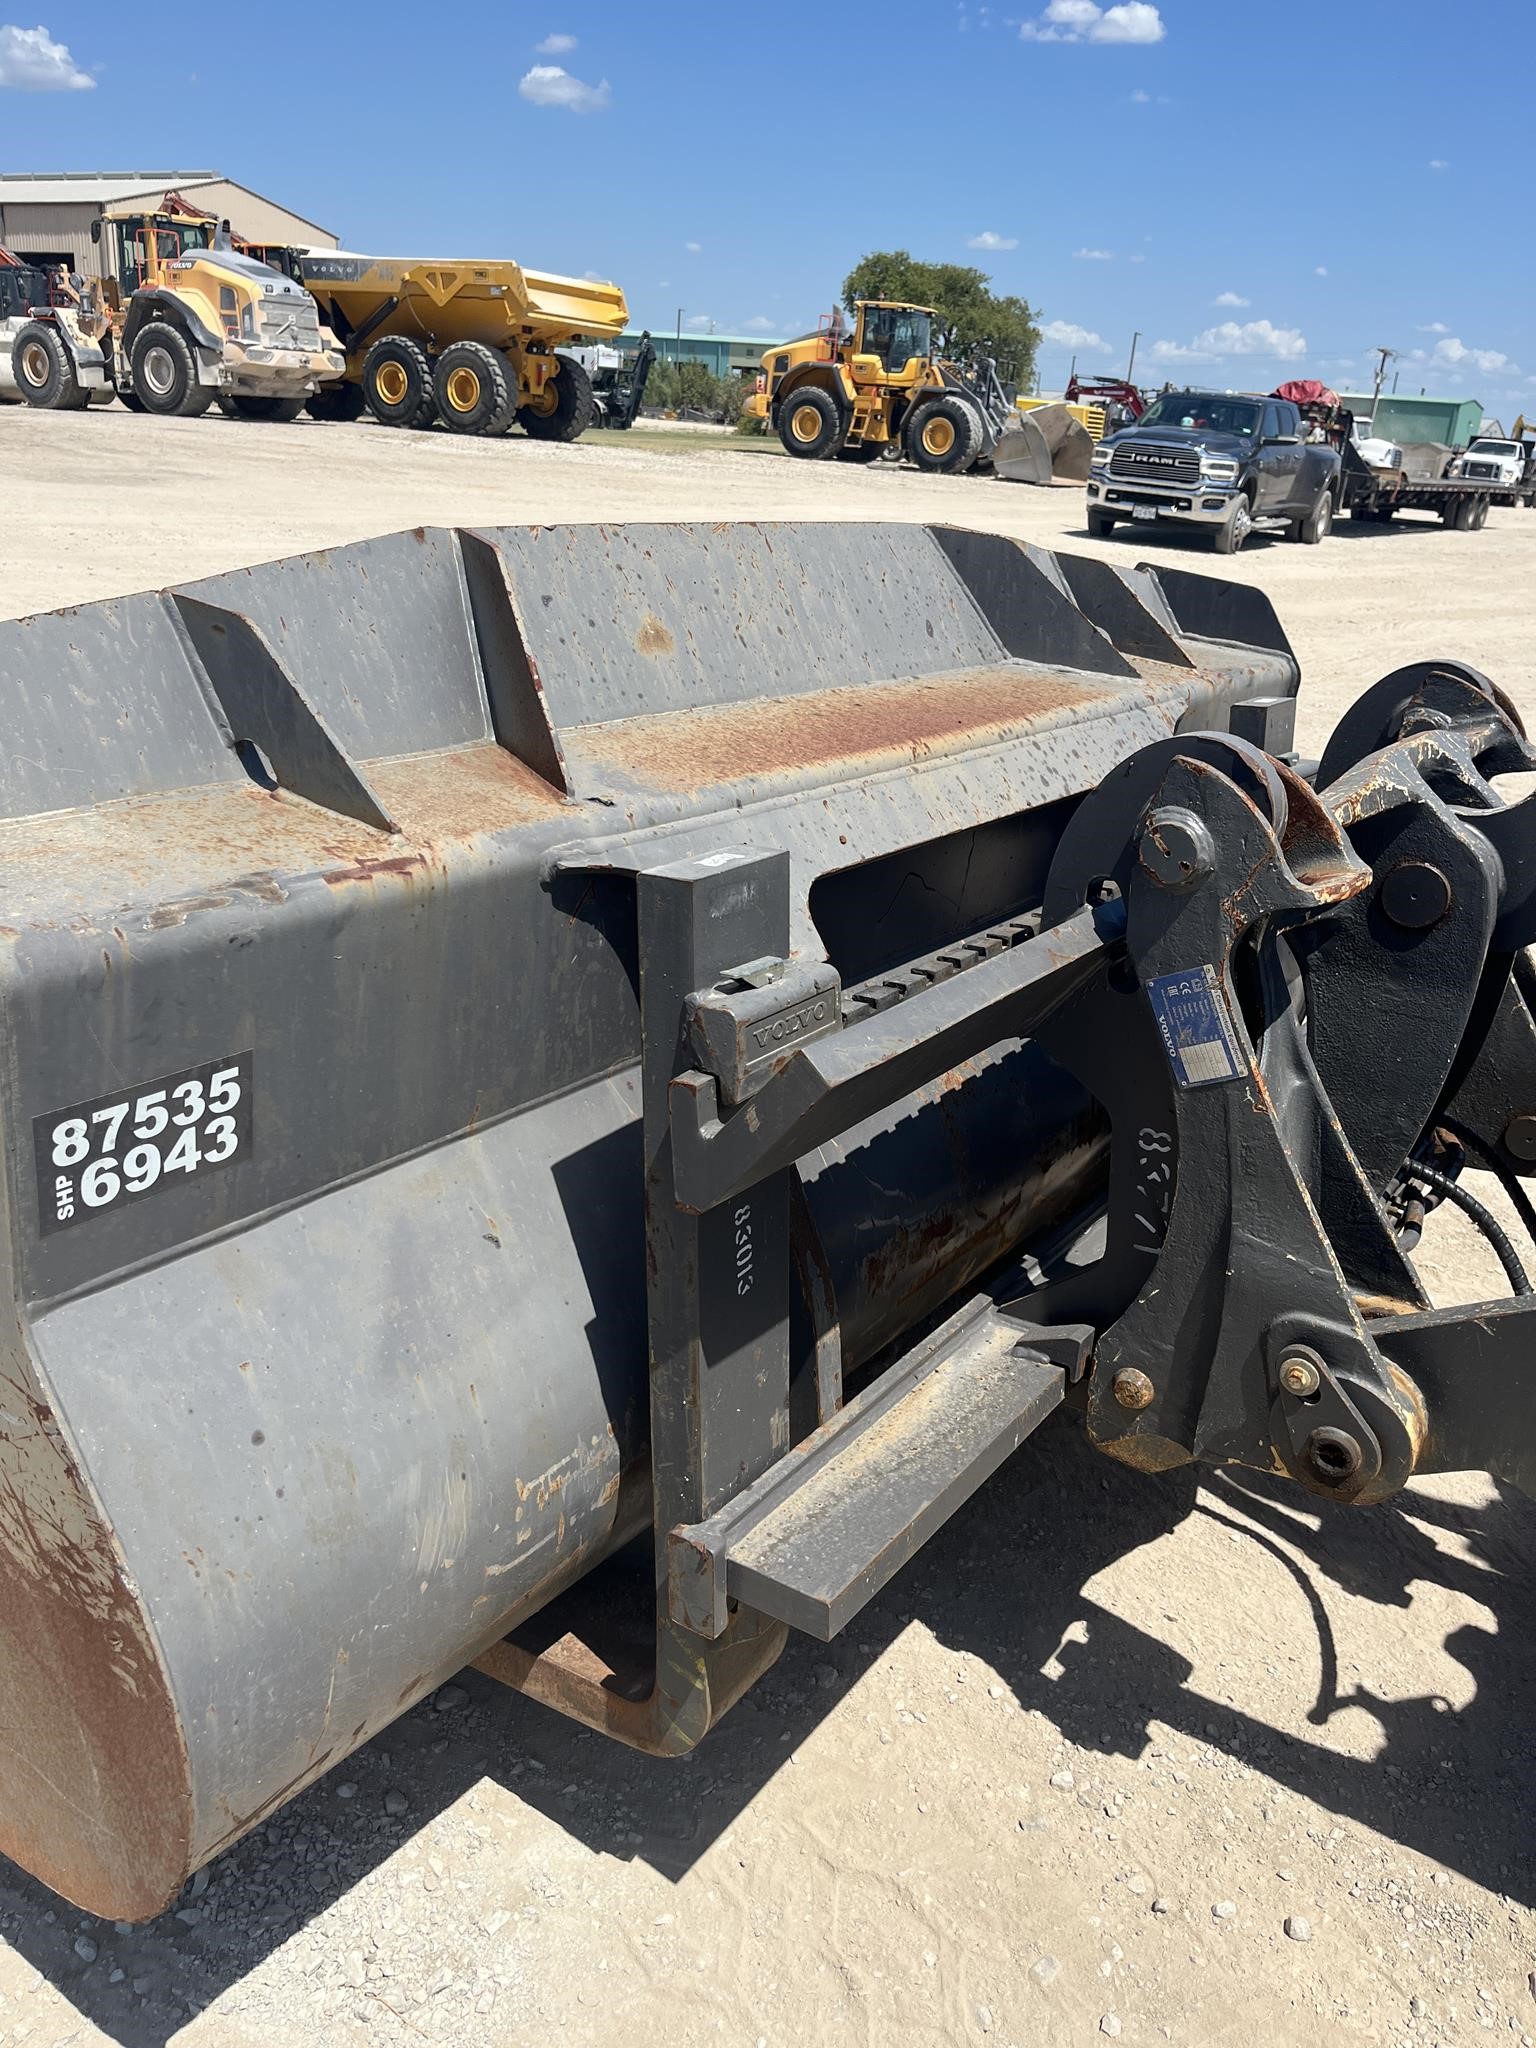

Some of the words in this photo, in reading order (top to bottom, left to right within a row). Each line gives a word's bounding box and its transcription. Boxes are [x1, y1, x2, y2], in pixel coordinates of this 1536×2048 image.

[311, 265, 353, 273] VOLVO
[1135, 454, 1175, 465] RAM
[753, 1001, 827, 1048] VOLVO
[1159, 1014, 1176, 1057] VOLVO
[1227, 1033, 1243, 1066] Equipment
[52, 1066, 241, 1167] 87535
[80, 1115, 239, 1208] 6943
[55, 1175, 74, 1221] SHP
[735, 1205, 753, 1295] 83013
